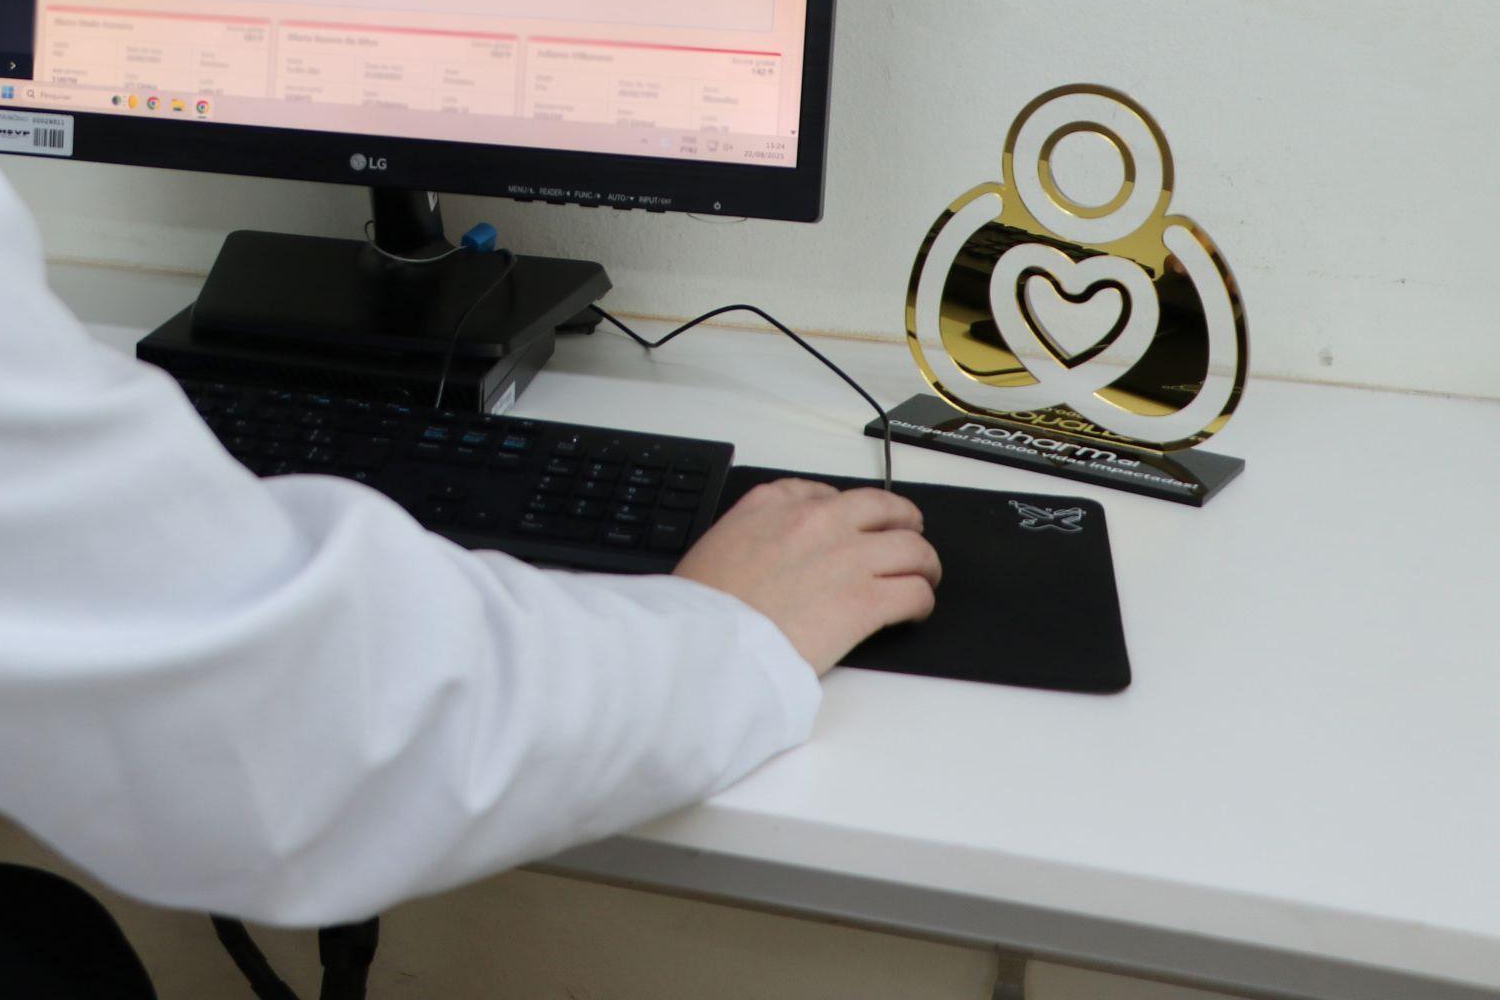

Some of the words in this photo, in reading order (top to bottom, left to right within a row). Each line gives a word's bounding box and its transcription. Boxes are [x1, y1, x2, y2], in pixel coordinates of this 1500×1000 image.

[369, 156, 387, 170] LG
[889, 418, 969, 442] Obrigado!
[970, 436, 1037, 455] 200.000
[1041, 451, 1086, 466] vidas
[1090, 460, 1199, 490] impactadas!
[959, 421, 1141, 469] noharm.ai
